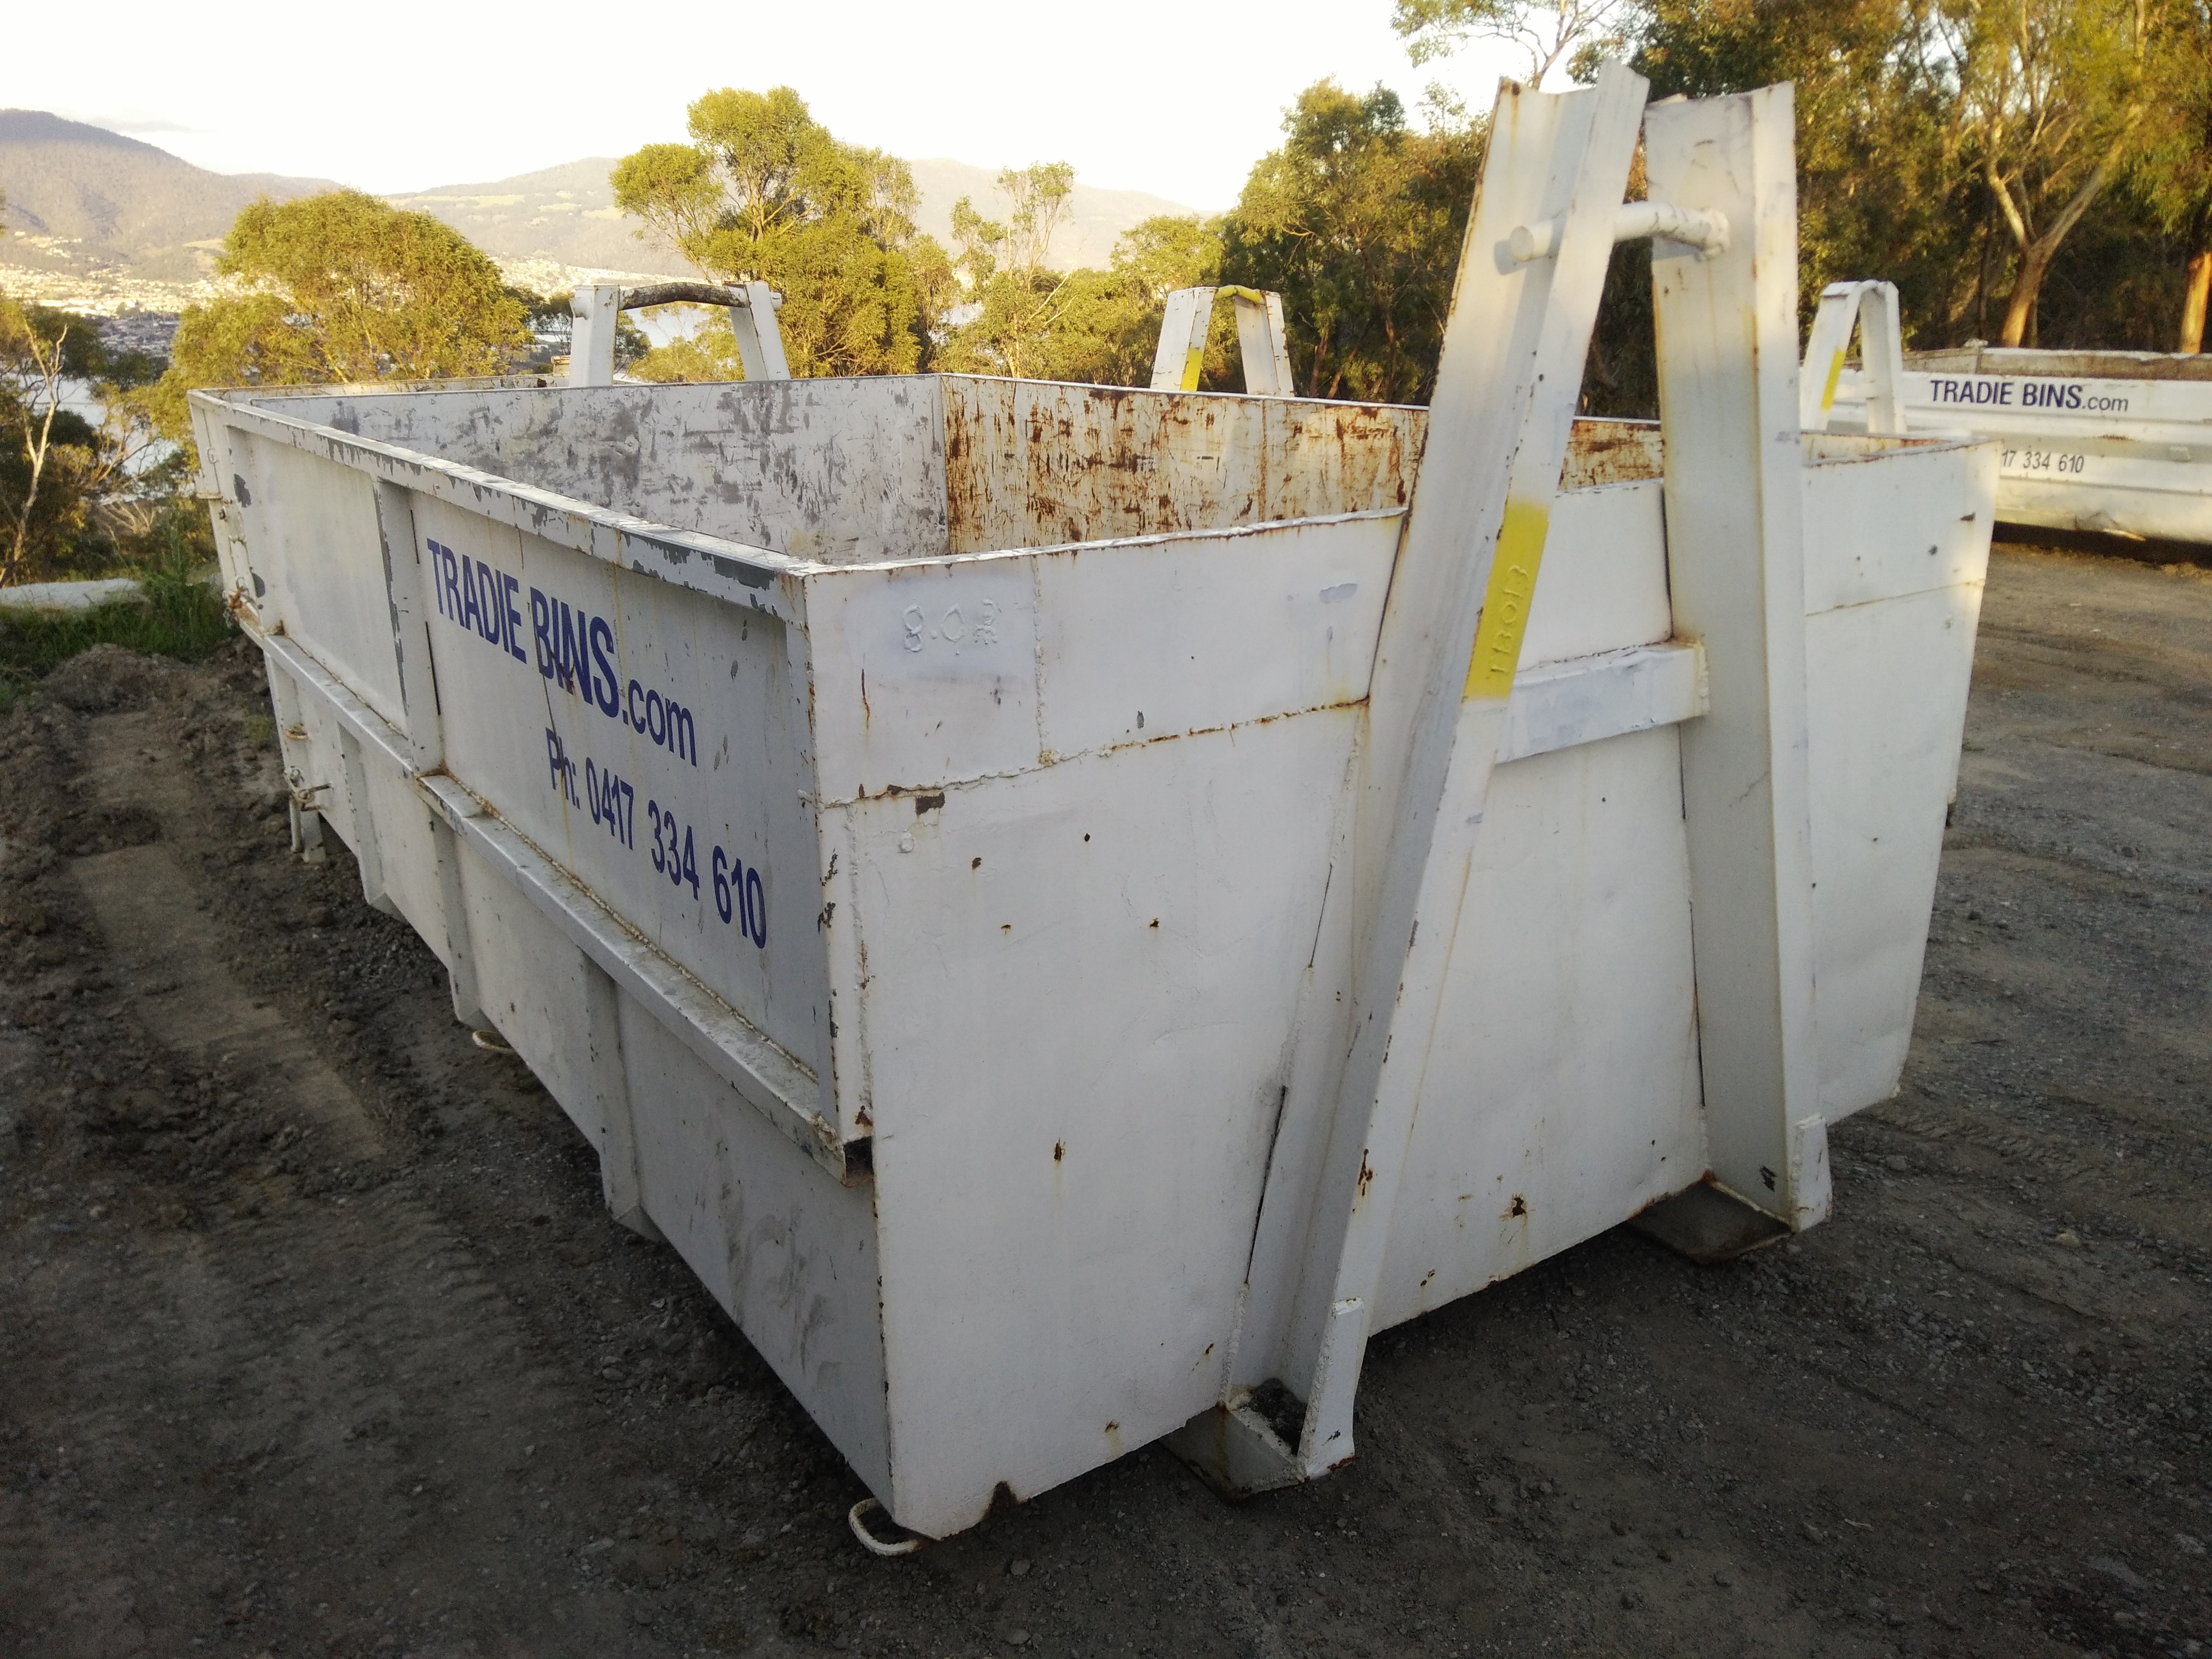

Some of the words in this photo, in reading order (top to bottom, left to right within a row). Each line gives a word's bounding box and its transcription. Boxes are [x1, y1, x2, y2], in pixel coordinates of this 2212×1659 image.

[1930, 380, 2014, 405] TRADIE
[2022, 382, 2129, 412] BINS.com
[2001, 450, 2017, 467] 17
[2023, 451, 2051, 470] 334
[2058, 454, 2084, 473] 610
[427, 537, 527, 664] TRADIE
[530, 586, 697, 767] BINS.com
[546, 727, 580, 810] Ph:
[585, 756, 633, 850] 0417
[648, 799, 699, 900] 334
[713, 845, 767, 950] 610
